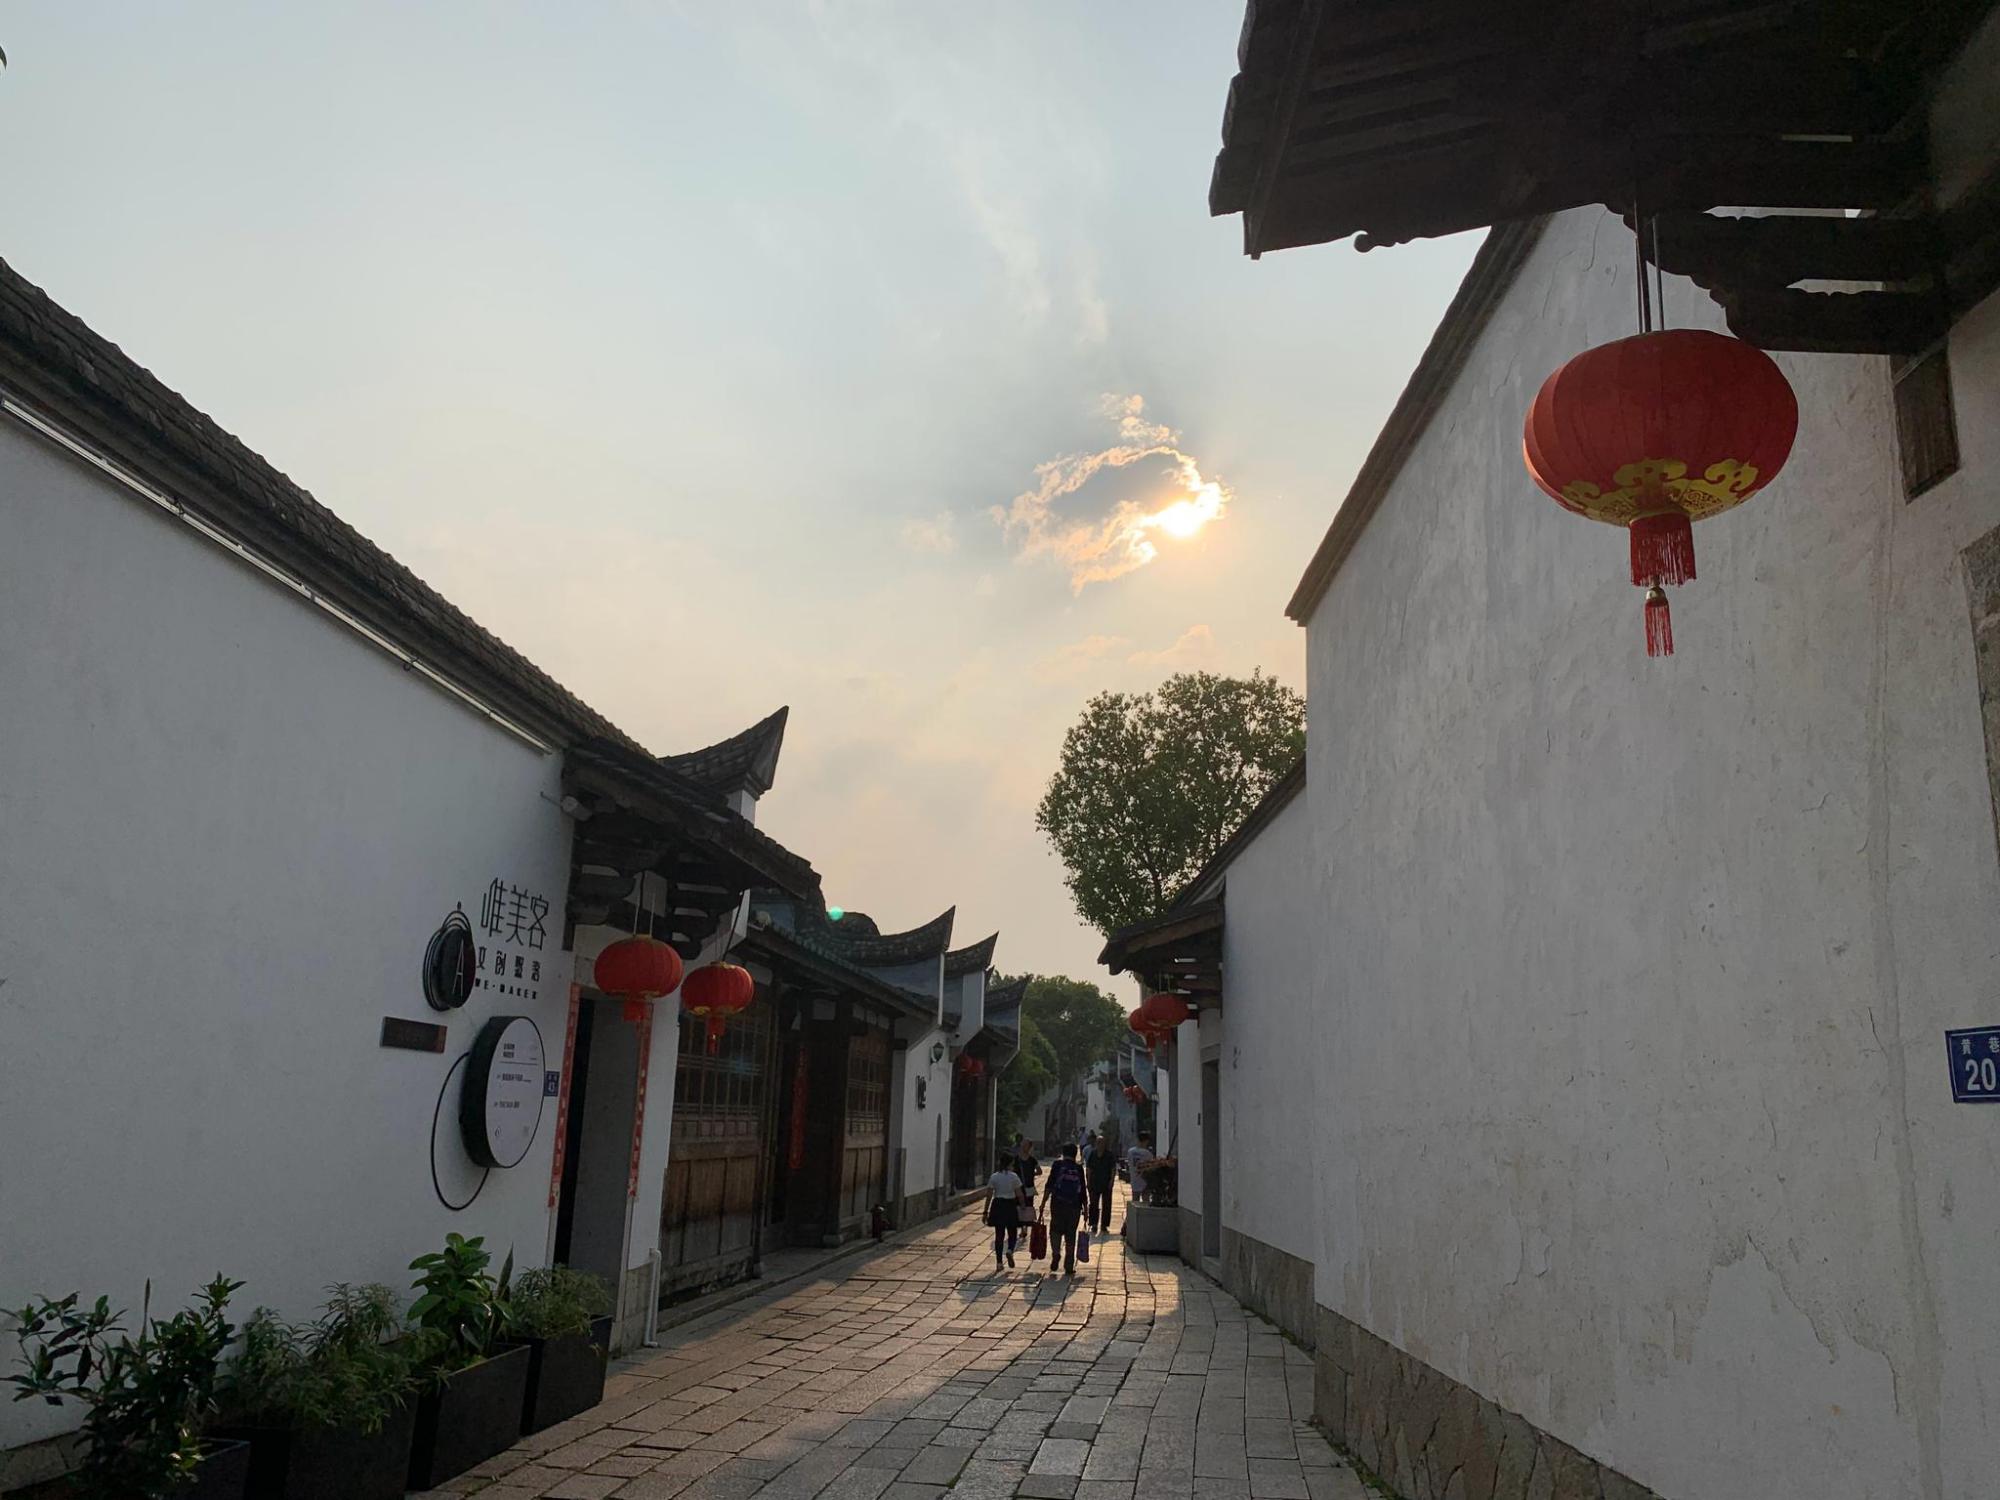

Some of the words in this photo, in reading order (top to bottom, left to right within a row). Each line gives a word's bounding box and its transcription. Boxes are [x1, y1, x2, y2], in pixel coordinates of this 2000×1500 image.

[481, 877, 549, 951] 唯美客
[1965, 1057, 1997, 1091] 20
